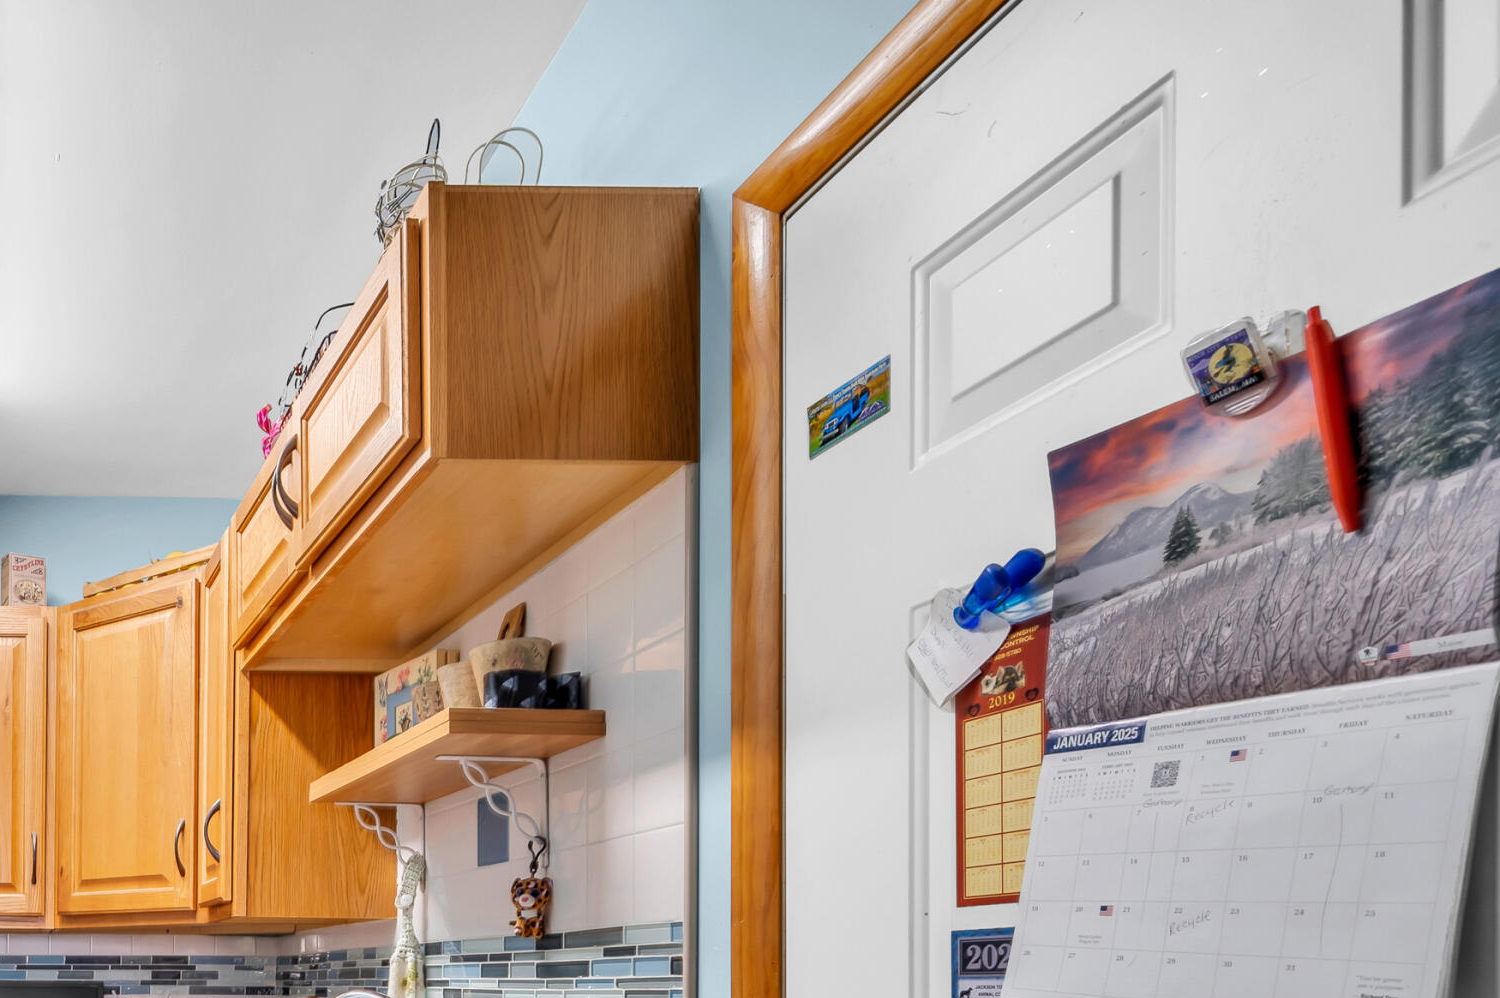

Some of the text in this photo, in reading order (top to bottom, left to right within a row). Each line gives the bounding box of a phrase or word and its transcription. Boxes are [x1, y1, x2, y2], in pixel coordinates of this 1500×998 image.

[988, 691, 1015, 709] 2019
[1338, 720, 1369, 729] FRIDAY
[1405, 709, 1454, 720] SATURDAY
[1053, 730, 1109, 750] JANUARY
[1111, 726, 1139, 743] 2025
[1185, 799, 1234, 826] Recycle
[1169, 910, 1211, 936] Recycle
[965, 943, 1011, 970] 202
